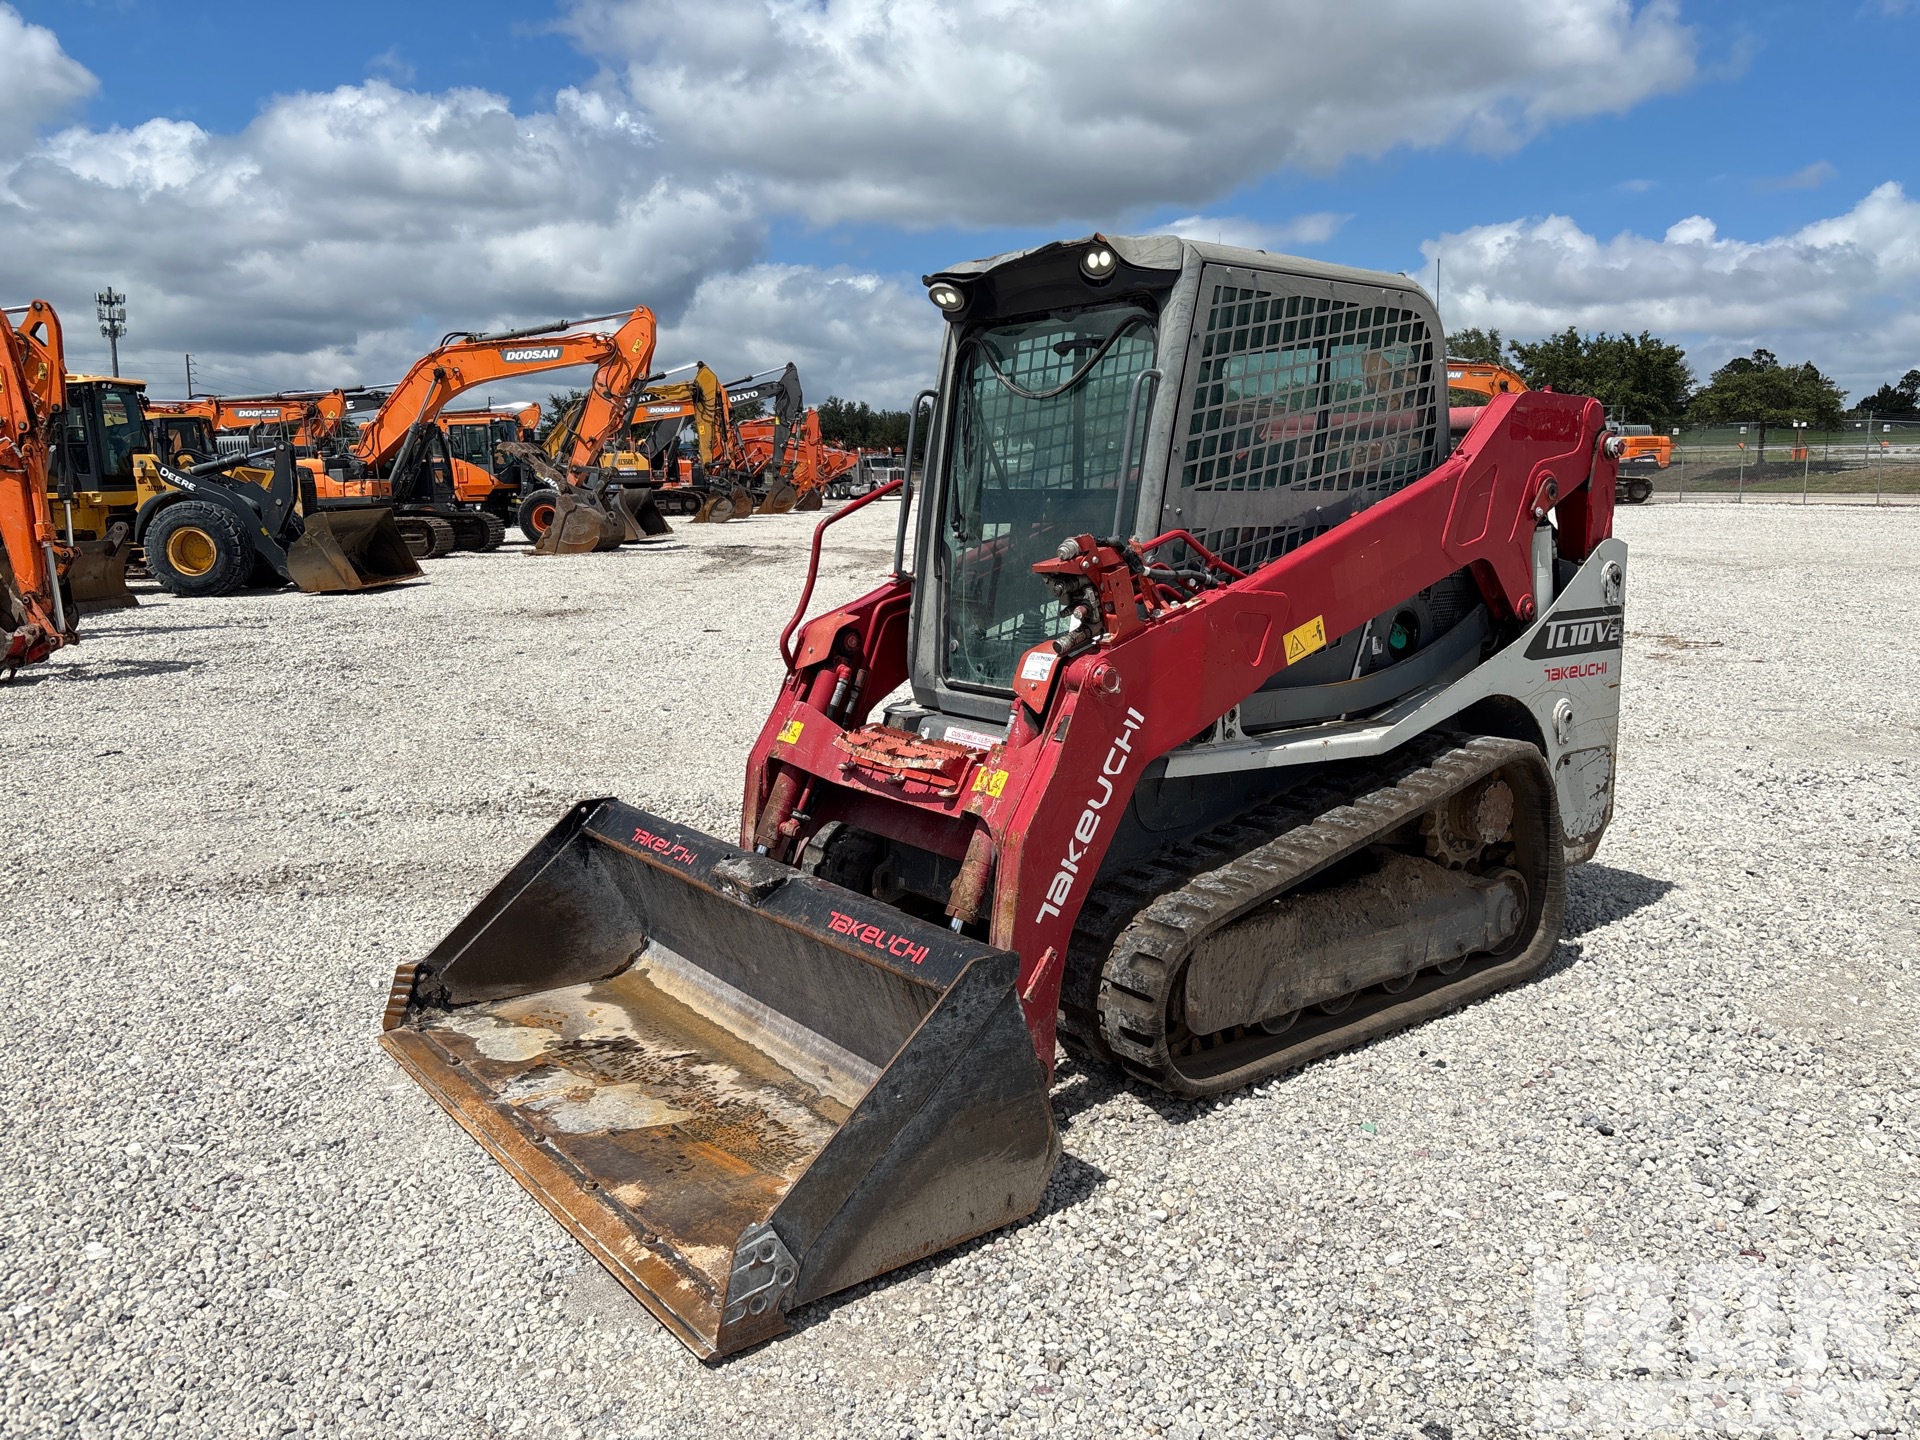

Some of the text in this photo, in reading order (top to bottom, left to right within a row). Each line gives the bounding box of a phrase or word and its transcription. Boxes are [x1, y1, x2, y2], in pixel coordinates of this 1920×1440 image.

[505, 348, 559, 361] DOOSAN
[729, 390, 759, 403] OLVO
[649, 406, 681, 414] DOOSAN
[159, 466, 197, 492] DEERE
[1544, 661, 1608, 682] TAKEUCHI
[1035, 706, 1145, 924] TAKEUCHI
[827, 910, 930, 965] TAKEUCHI
